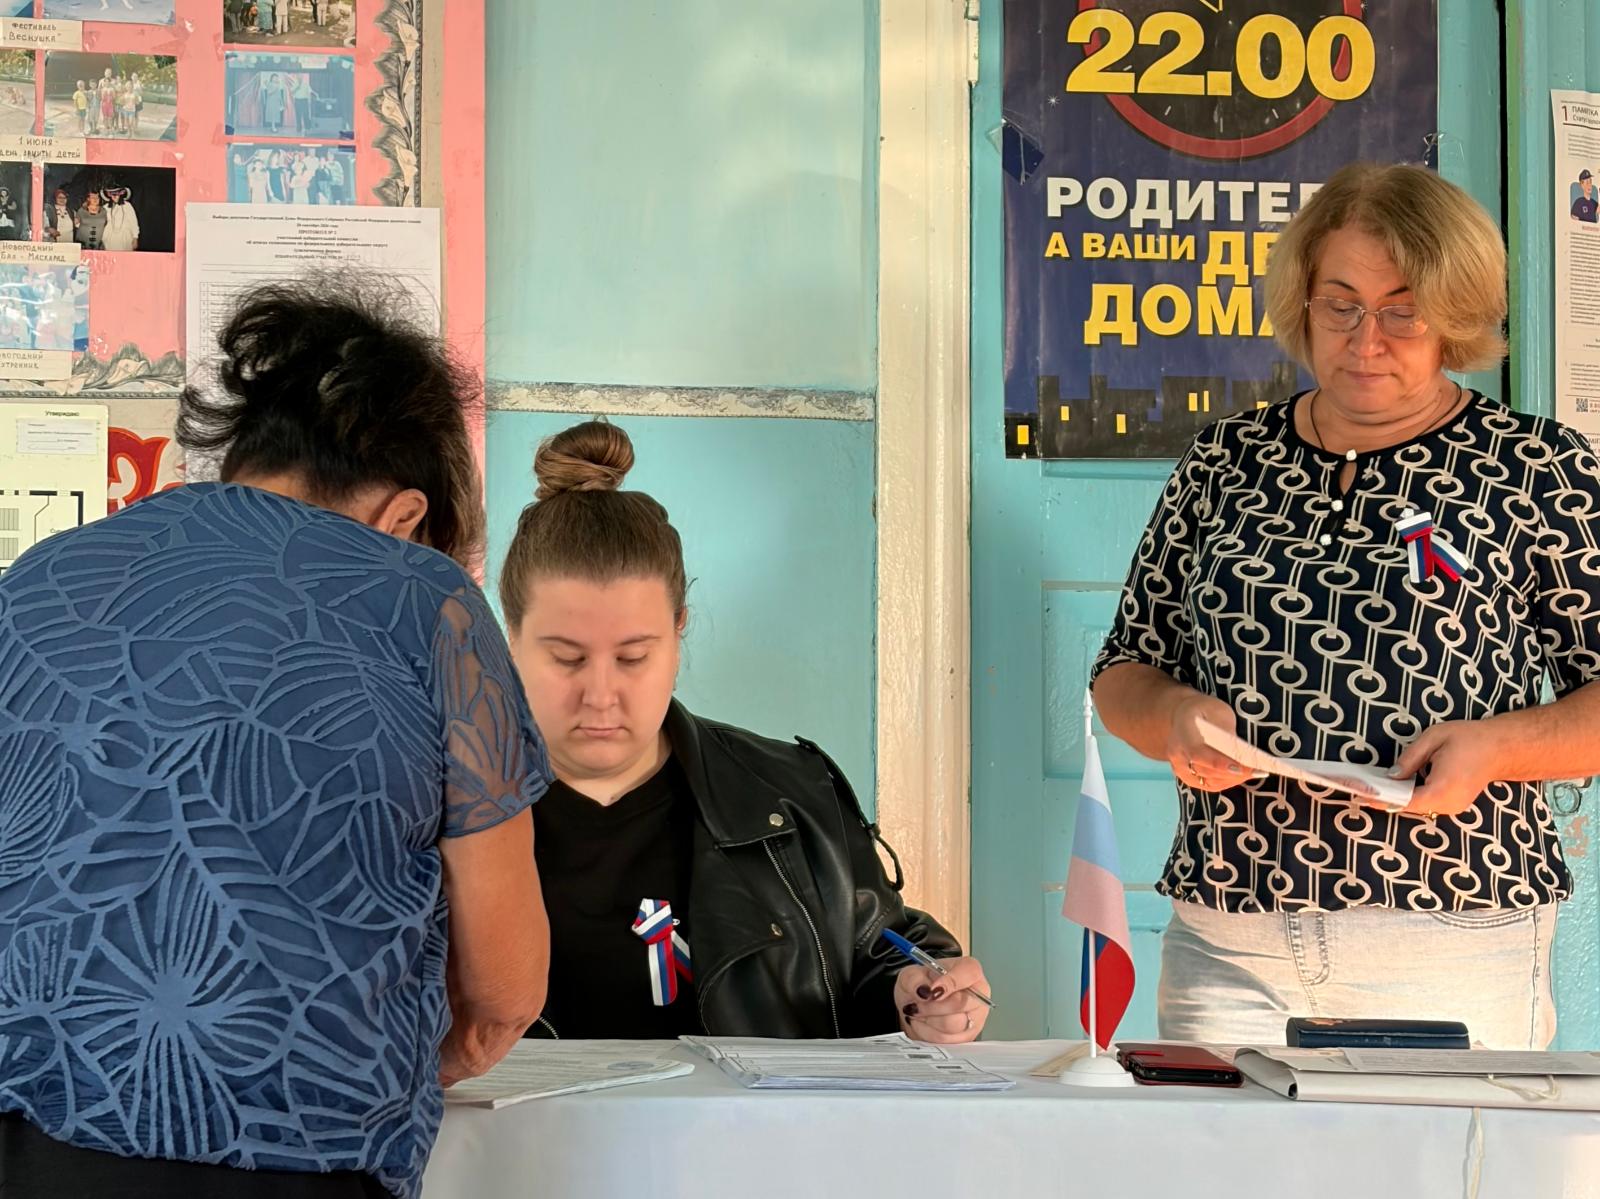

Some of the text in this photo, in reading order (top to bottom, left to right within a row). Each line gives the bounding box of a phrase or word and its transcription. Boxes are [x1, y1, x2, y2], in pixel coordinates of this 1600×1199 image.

[1066, 8, 1376, 101] 22.00
[1561, 105, 1568, 122] 1
[1044, 232, 1070, 259] А
[1082, 233, 1196, 261] ВАШИ
[1083, 284, 1275, 346] ДОМ
